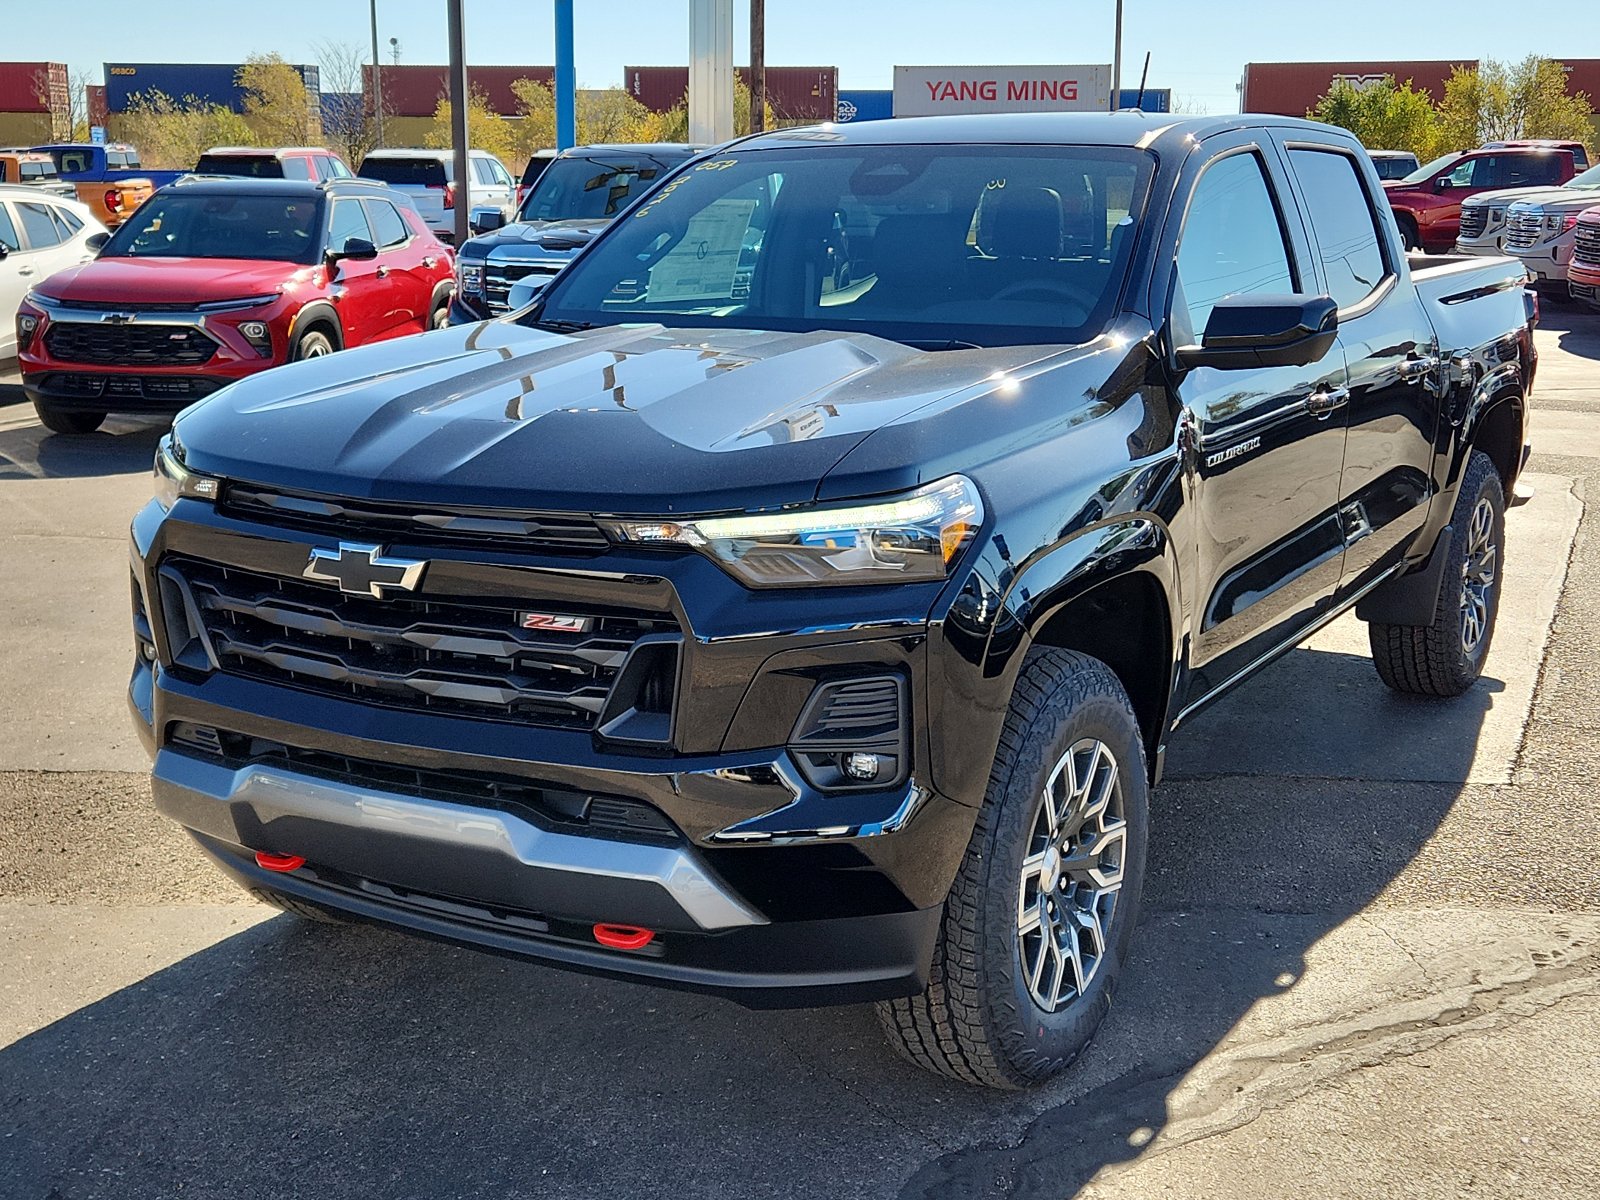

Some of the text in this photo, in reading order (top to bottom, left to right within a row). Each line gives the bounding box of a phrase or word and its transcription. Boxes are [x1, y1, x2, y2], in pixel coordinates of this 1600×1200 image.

[110, 67, 136, 75] seaco
[926, 80, 1078, 101] YANG MING
